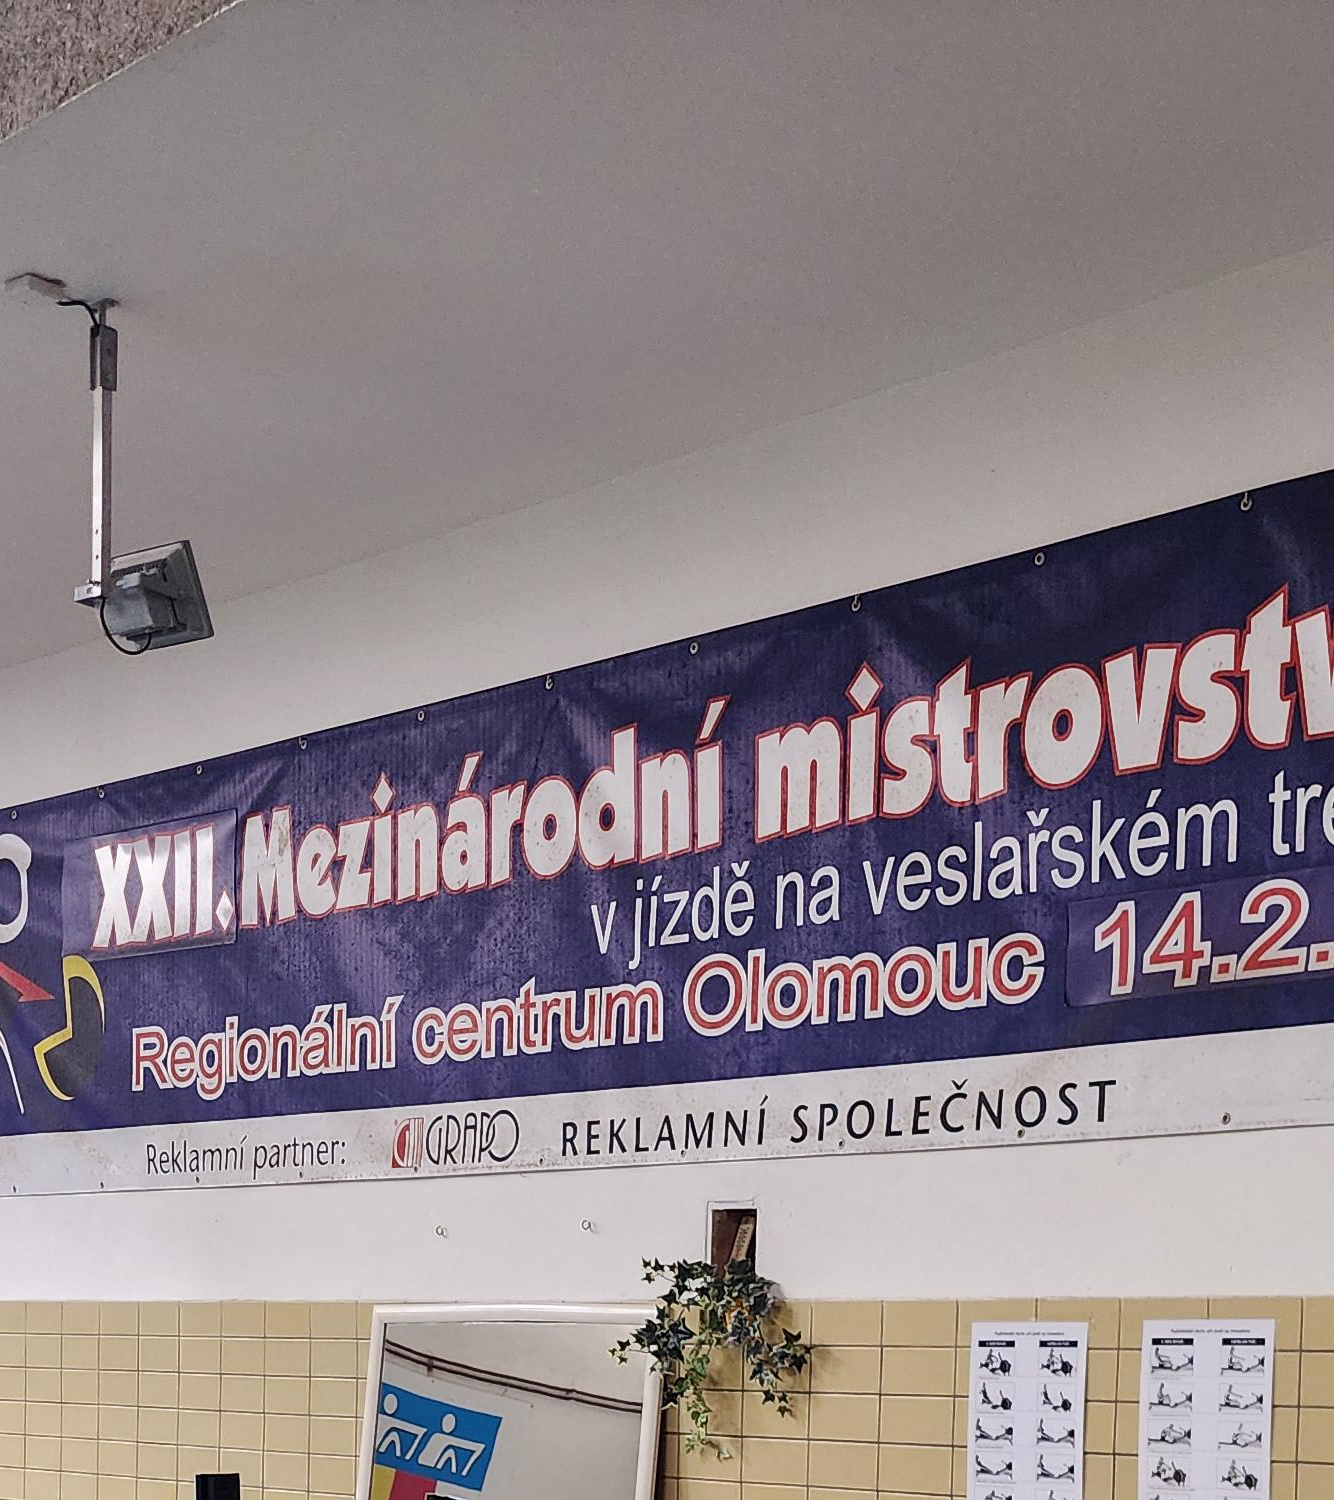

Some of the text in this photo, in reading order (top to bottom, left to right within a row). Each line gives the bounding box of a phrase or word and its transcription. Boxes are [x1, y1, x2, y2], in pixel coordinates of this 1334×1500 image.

[90, 823, 235, 951] XXII.
[239, 695, 732, 929] Mezinárodní
[589, 899, 618, 956] v
[627, 859, 755, 970] jízdě
[774, 864, 841, 931] na
[861, 789, 1239, 916] veslařském
[131, 994, 404, 1101] Regionální
[411, 976, 664, 1066] centrum
[682, 931, 1046, 1038] Olomouc
[145, 1133, 248, 1175] Reklamní
[252, 1136, 347, 1181] partner:
[561, 1095, 769, 1158] REKLAMNÍ
[789, 1078, 1117, 1145] SPOLEČNOST
